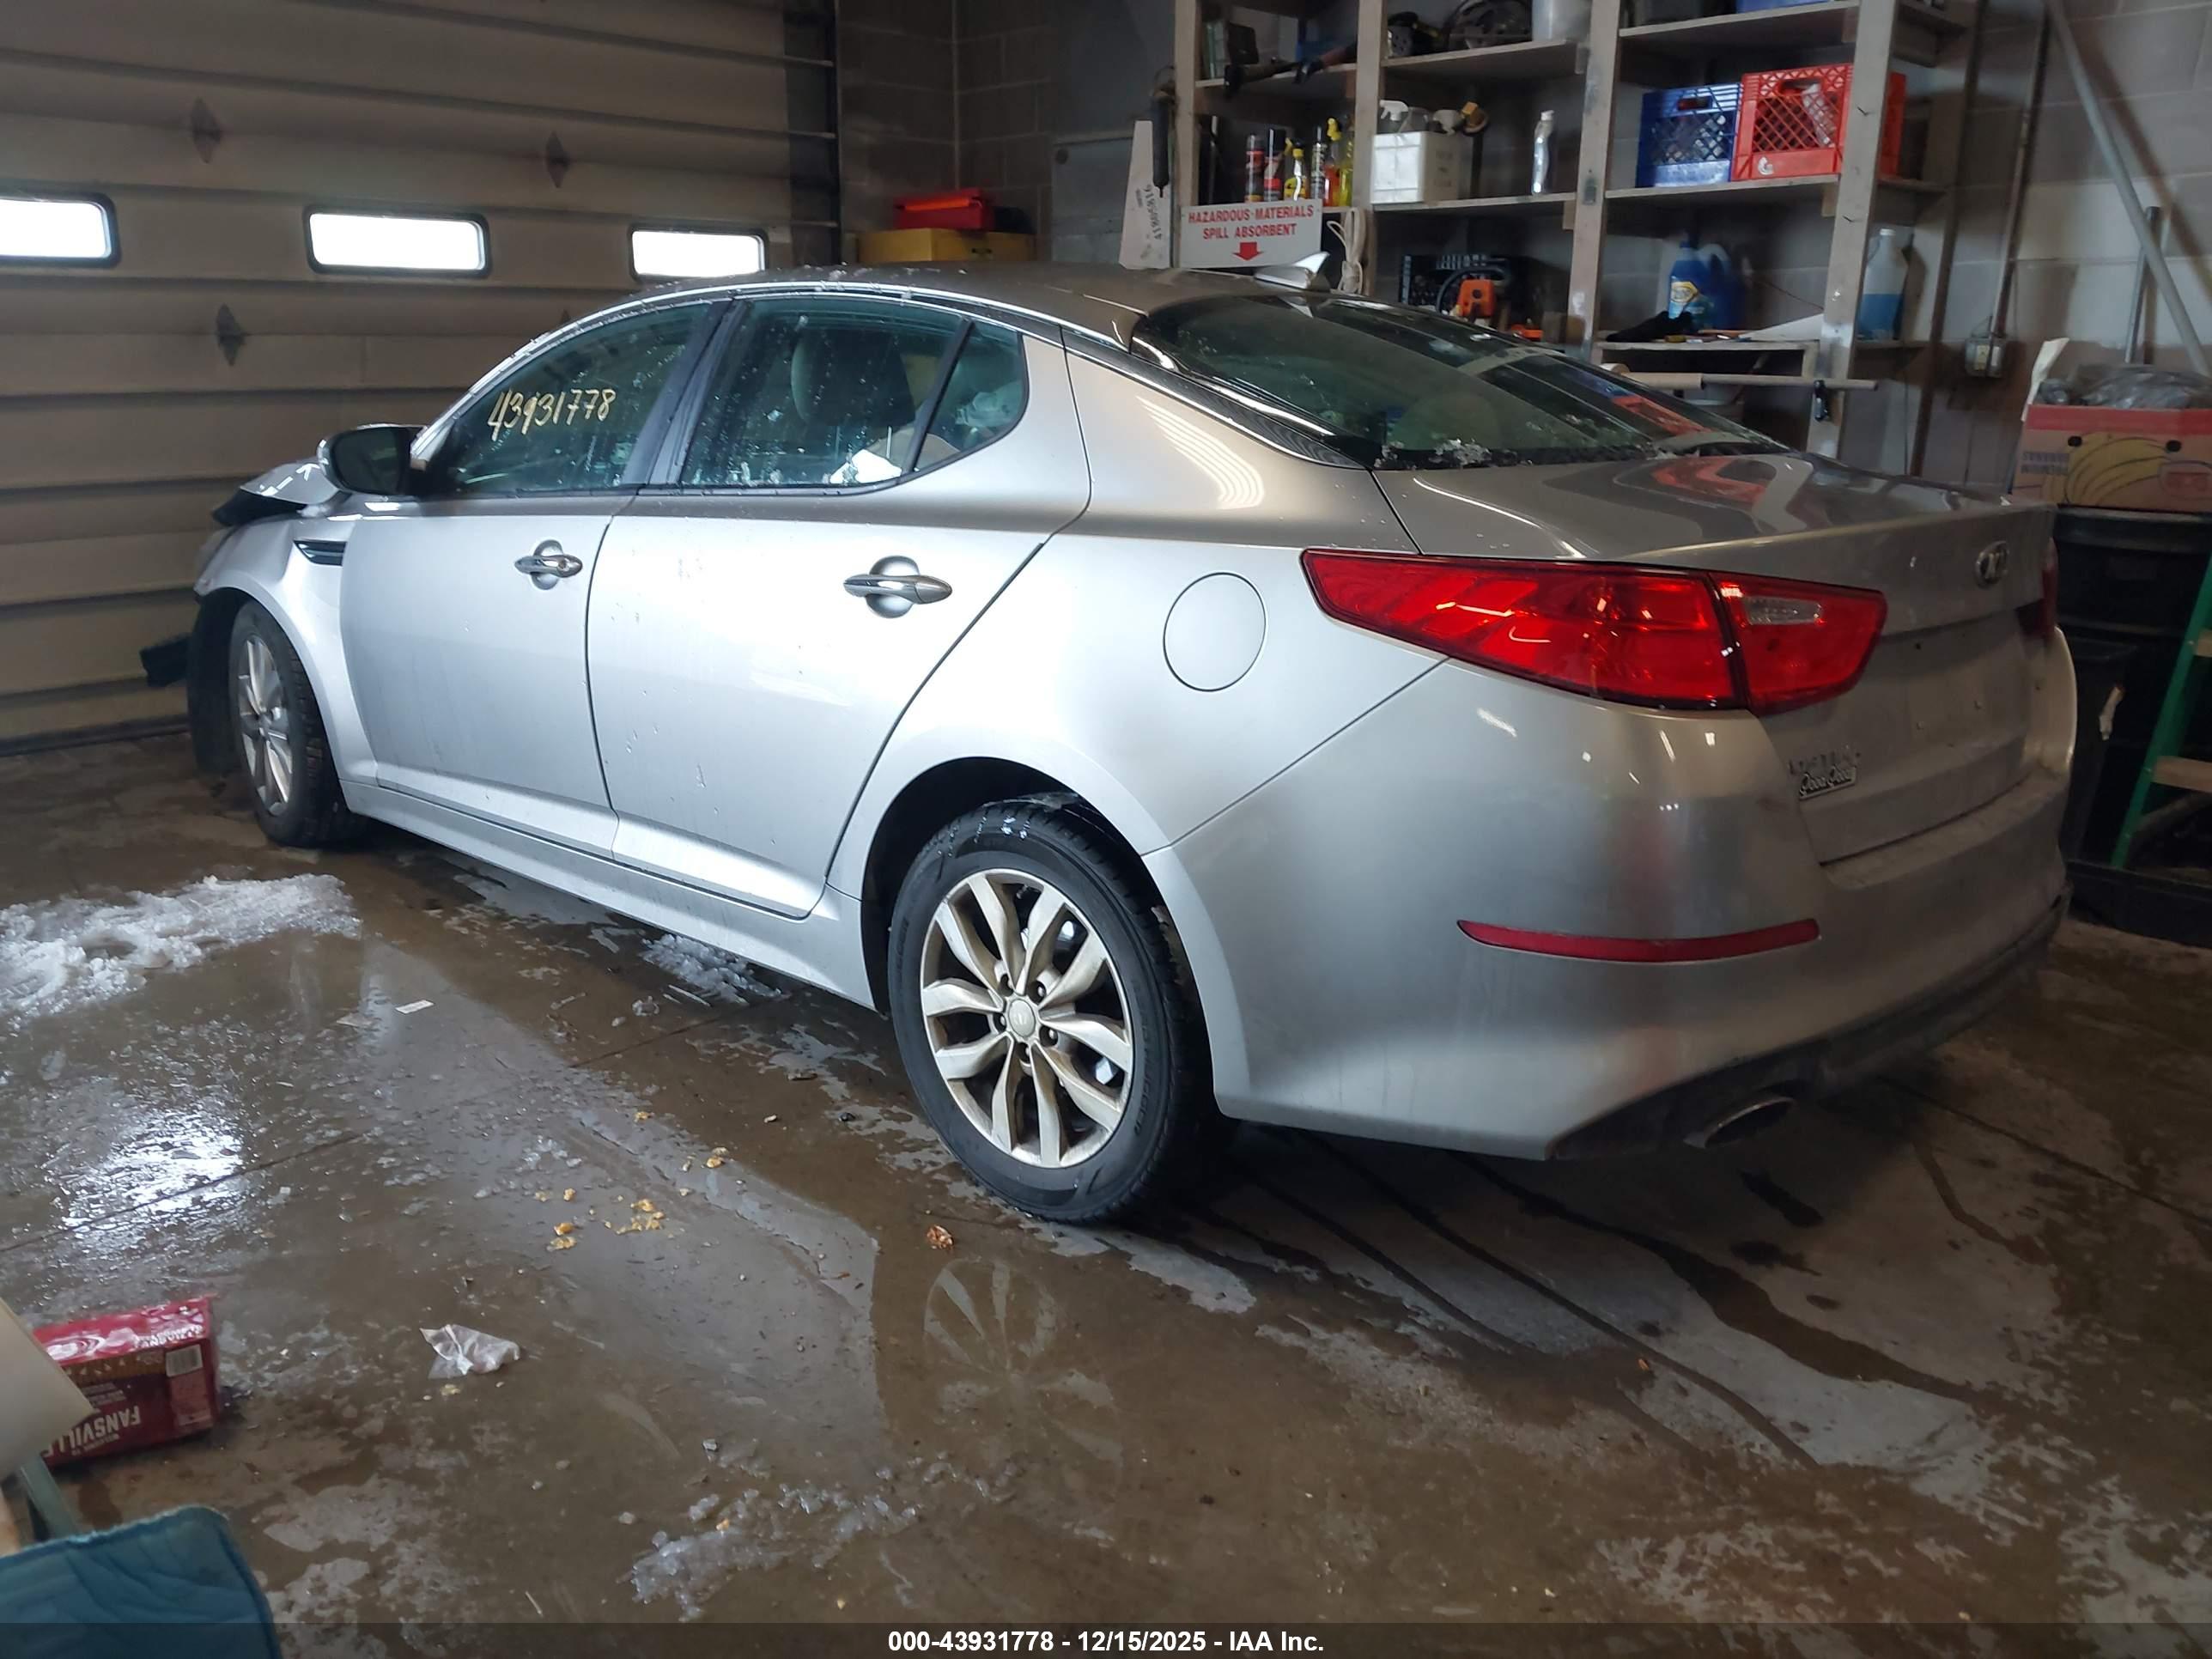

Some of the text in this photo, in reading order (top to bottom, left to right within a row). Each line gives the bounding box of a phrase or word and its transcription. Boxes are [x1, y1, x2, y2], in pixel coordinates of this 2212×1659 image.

[1188, 204, 1314, 224] HAZARDOUS MATERIALS
[1202, 223, 1297, 240] SPILL ABSORBENT
[487, 387, 617, 442] 43931778
